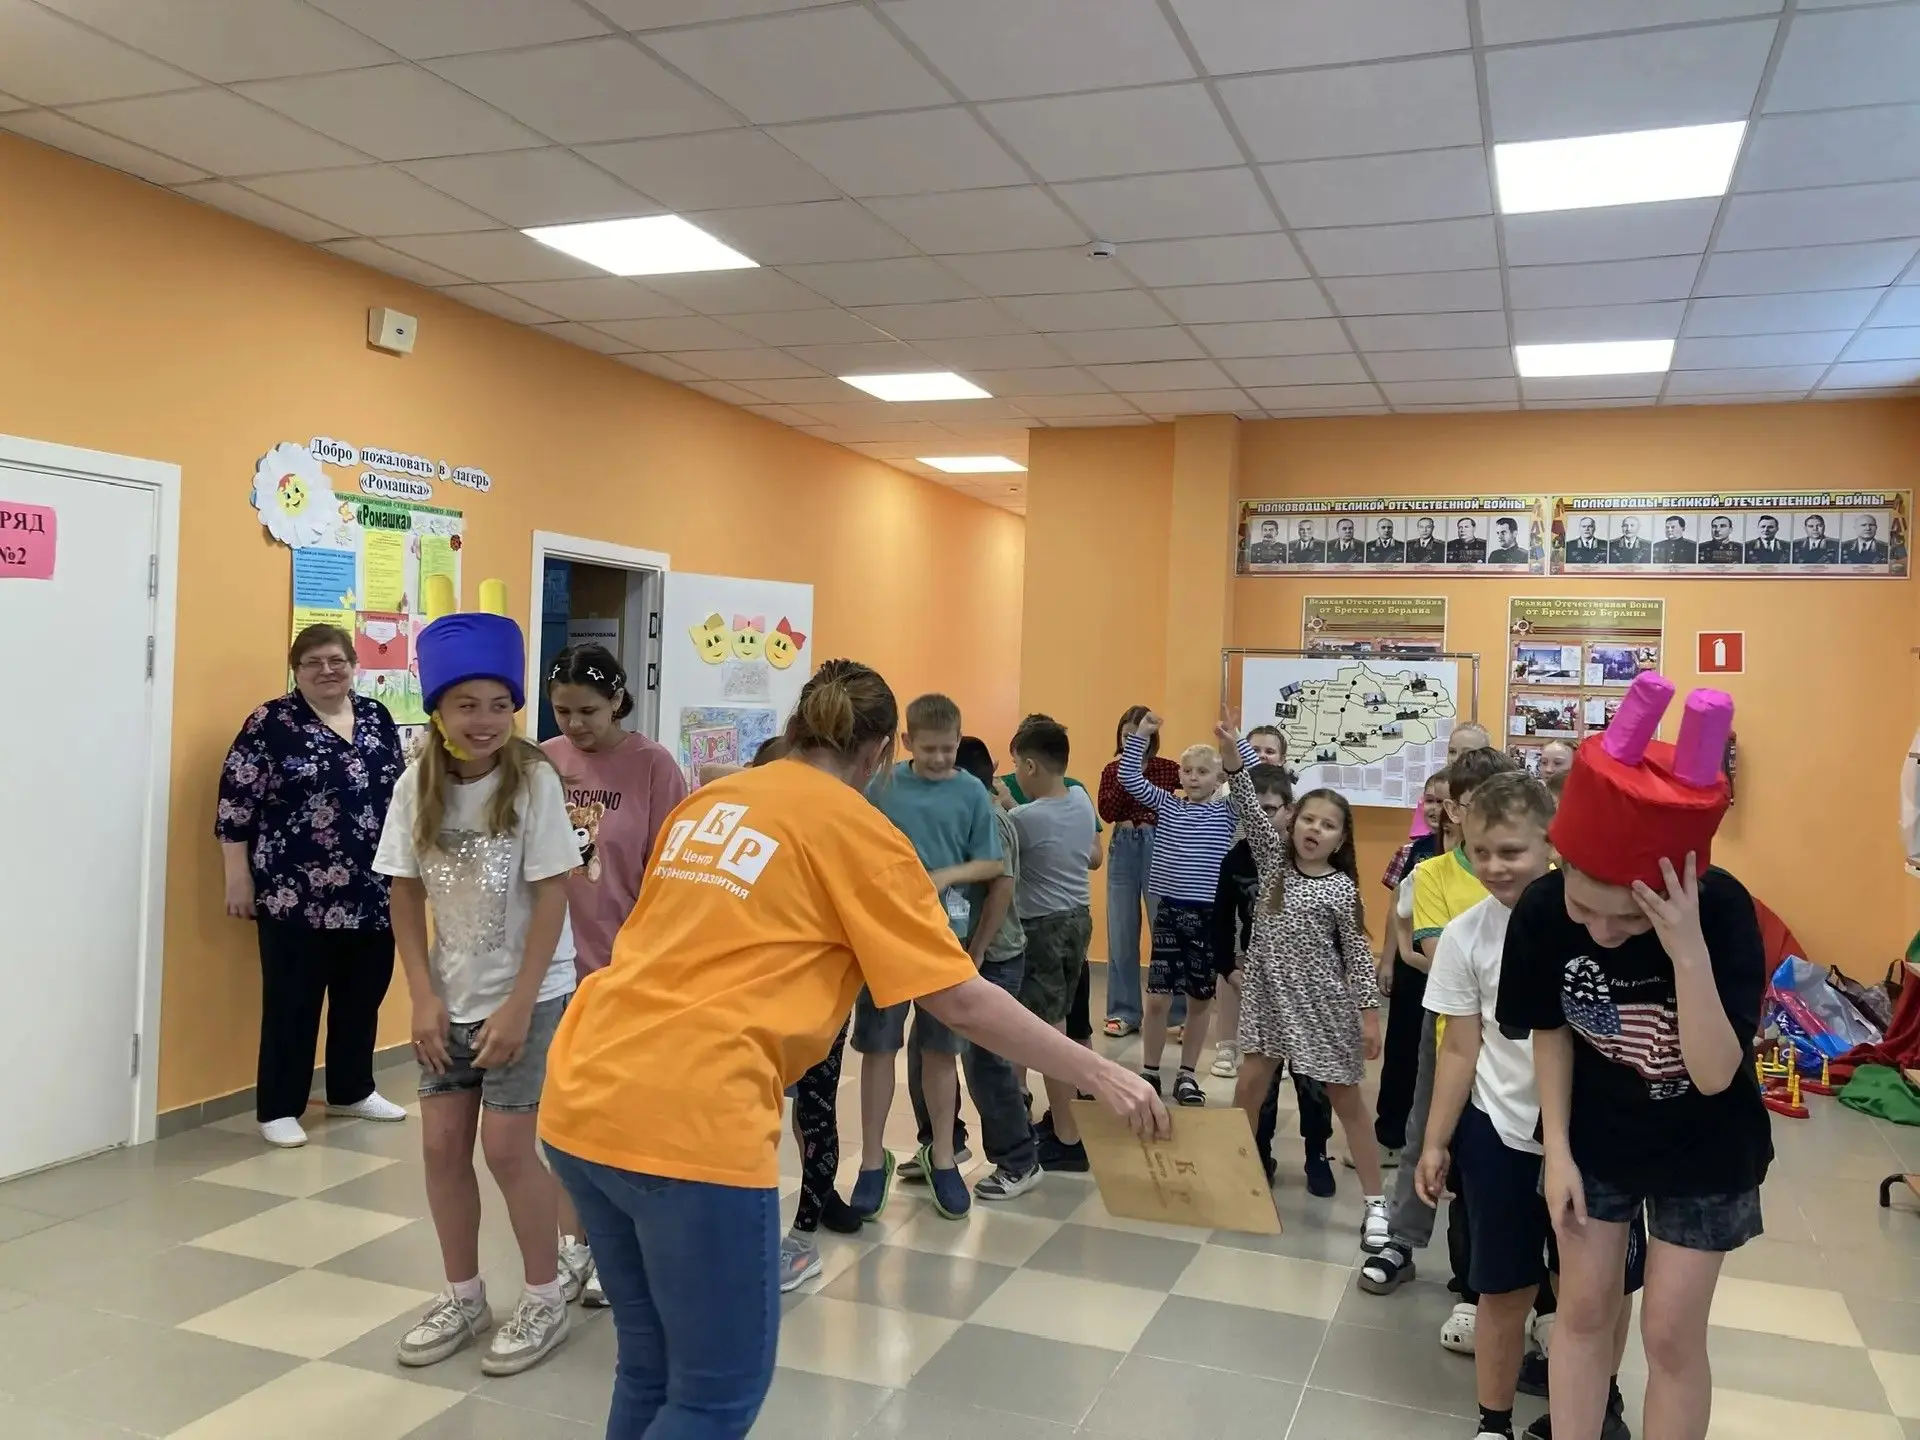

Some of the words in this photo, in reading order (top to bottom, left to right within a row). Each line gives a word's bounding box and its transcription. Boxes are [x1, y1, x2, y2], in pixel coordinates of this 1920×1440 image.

[311, 439, 353, 461] Добро
[361, 448, 433, 474] пожаловать
[439, 464, 446, 476] в
[452, 468, 490, 488] лагерь
[360, 473, 430, 496] «Ромашка»
[1257, 502, 1331, 513] ПОЛКОВОДЦЫ
[1334, 498, 1385, 511] ВЕЛИКОЙ
[1388, 496, 1479, 510] ОТЕЧЕСТВЕННОЙ
[1483, 496, 1526, 509] ВОЙНЫ
[1573, 498, 1658, 509] ПОЛКОВОДЦЫ
[1662, 494, 1720, 507] ВЕЛИКОЙ
[1724, 493, 1830, 507] ОТЕЧЕСТВЕННОЙ
[1835, 491, 1885, 506] ВОЙНЫ
[357, 504, 412, 530] «Ромашка»
[1334, 606, 1369, 615] Бреста
[1388, 606, 1431, 615] Берлина
[1542, 608, 1579, 617] Бреста
[1582, 608, 1596, 617] до
[1599, 608, 1646, 618] Берлина
[567, 789, 622, 811] SCHINO
[681, 848, 714, 866] Центр
